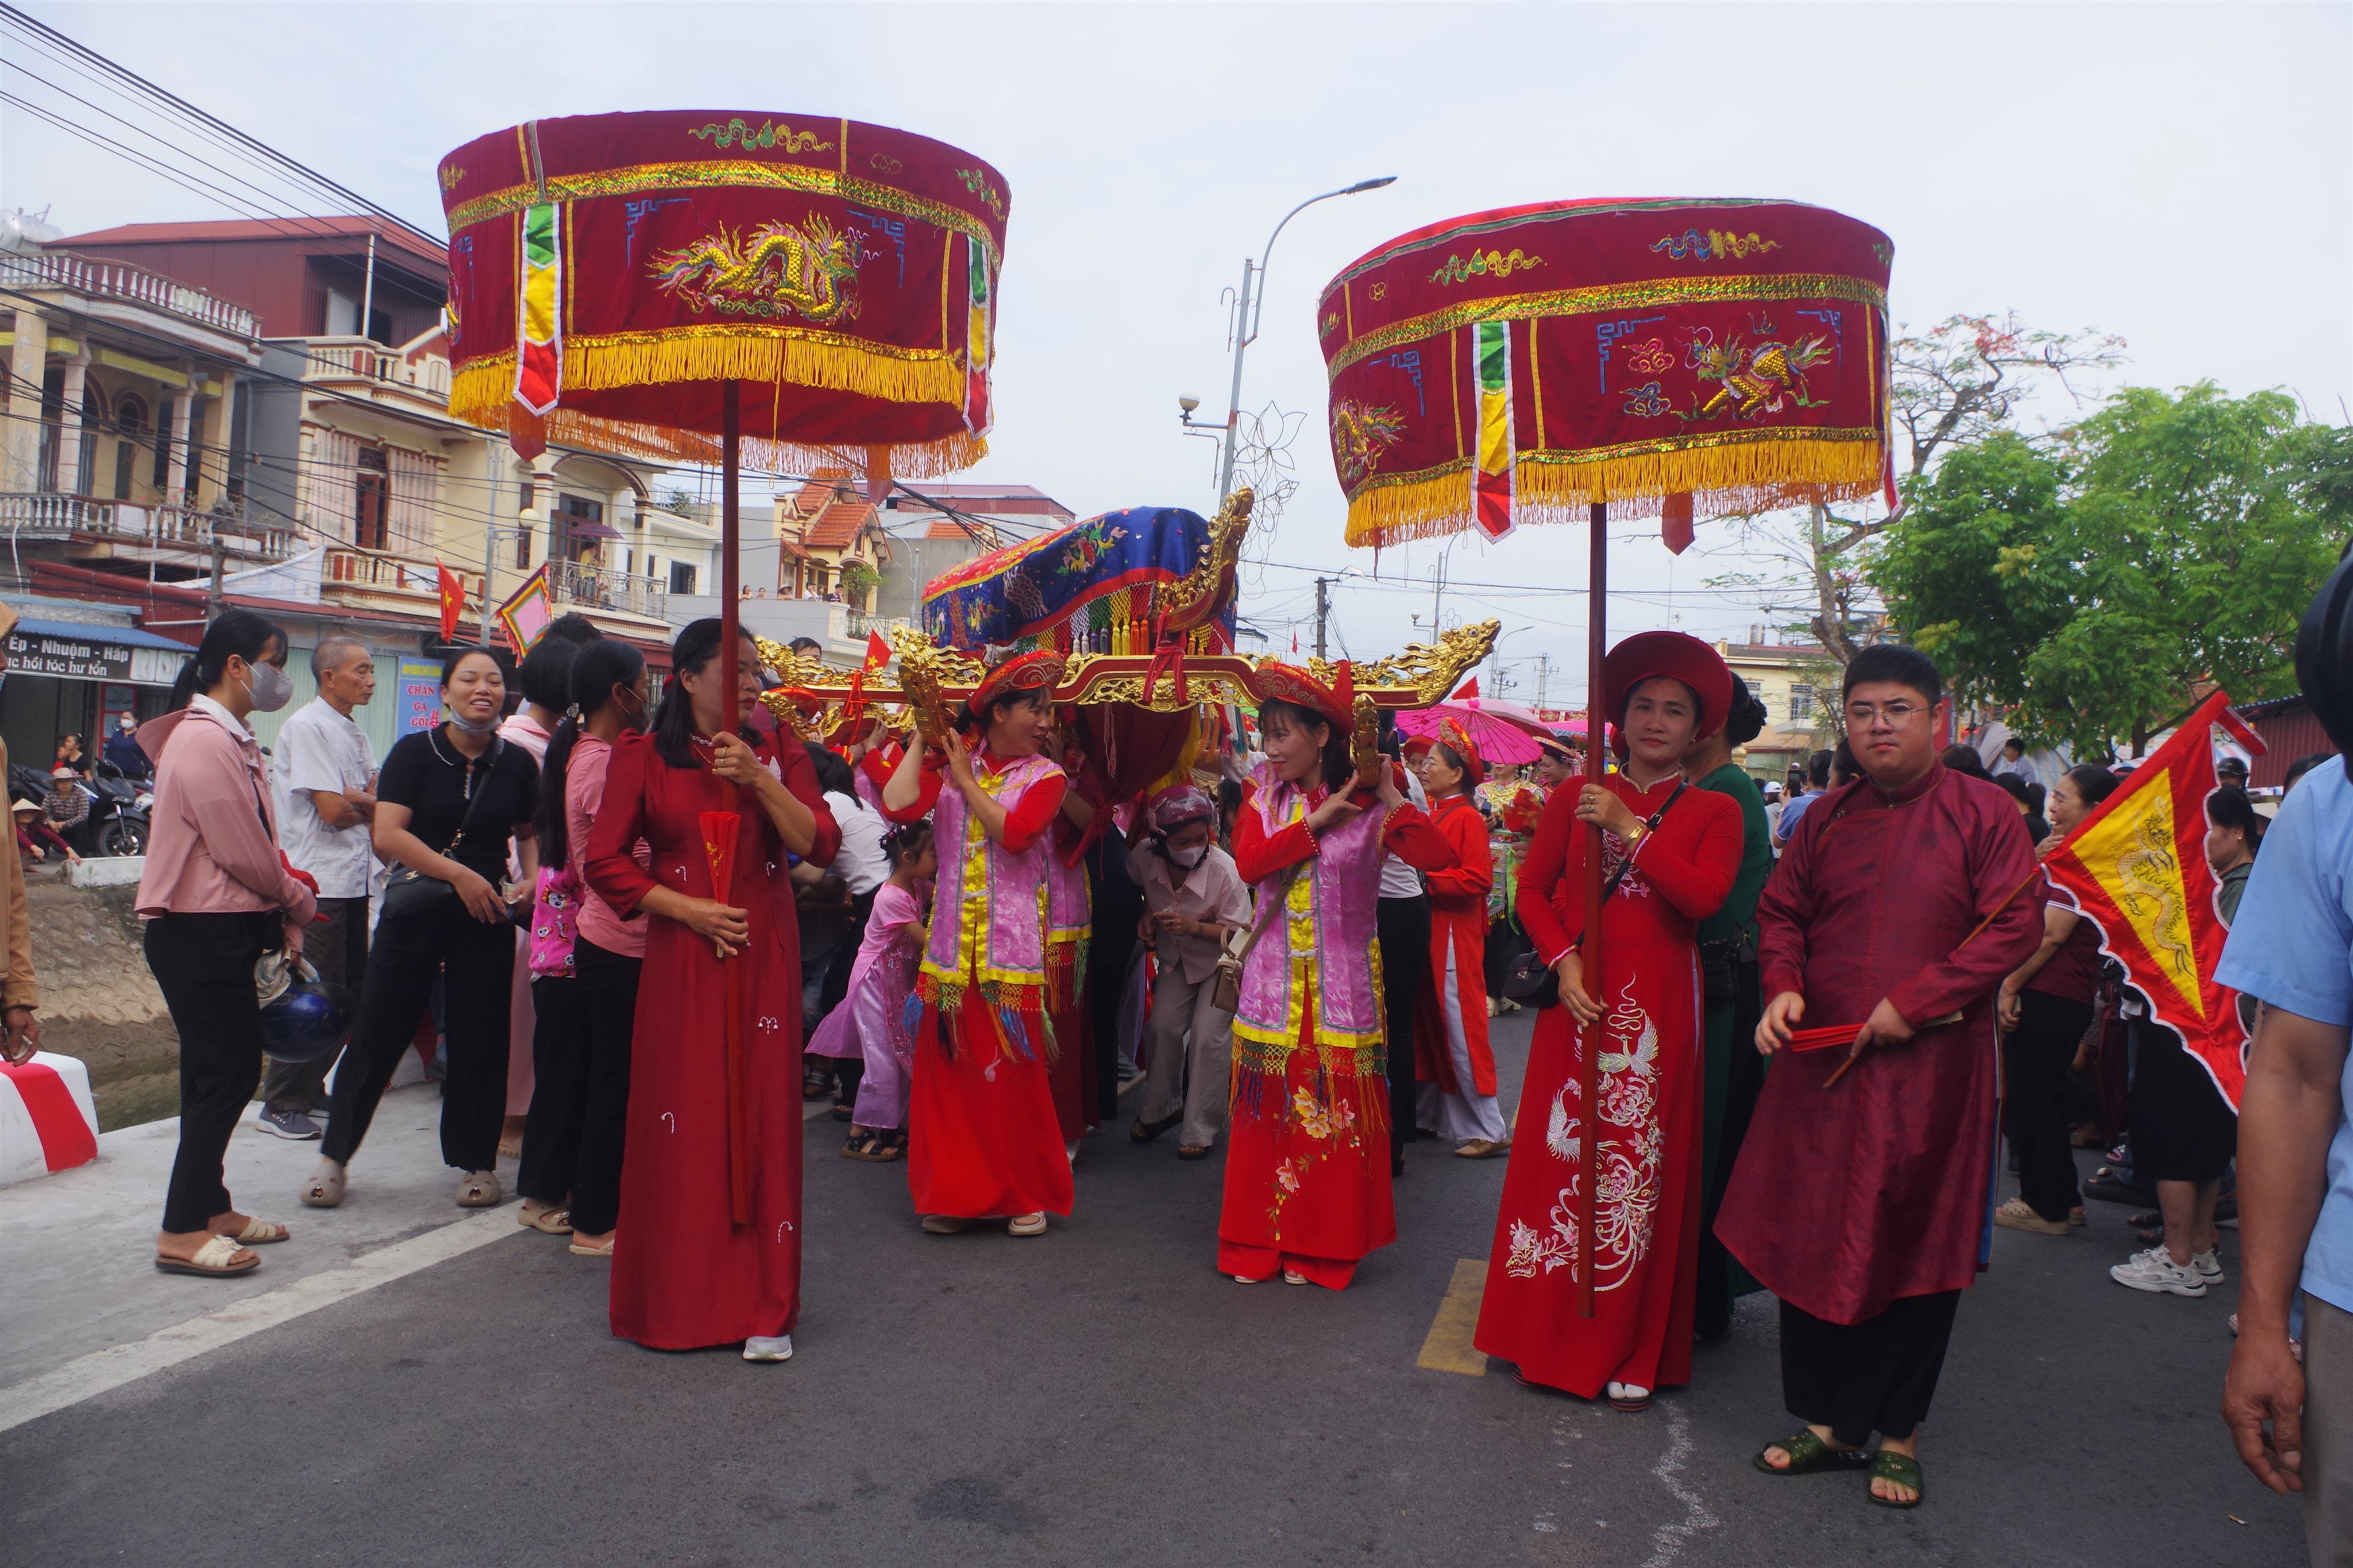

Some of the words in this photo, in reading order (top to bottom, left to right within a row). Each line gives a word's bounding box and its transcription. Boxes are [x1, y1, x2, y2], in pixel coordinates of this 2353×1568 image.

[9, 634, 28, 652] Ép
[41, 639, 91, 659] Nhuộm
[103, 645, 129, 663] Hấp
[23, 656, 43, 670] hồi
[46, 659, 66, 673] tóc
[68, 661, 86, 674] hư
[88, 660, 107, 676] tổn
[412, 701, 428, 712] GA
